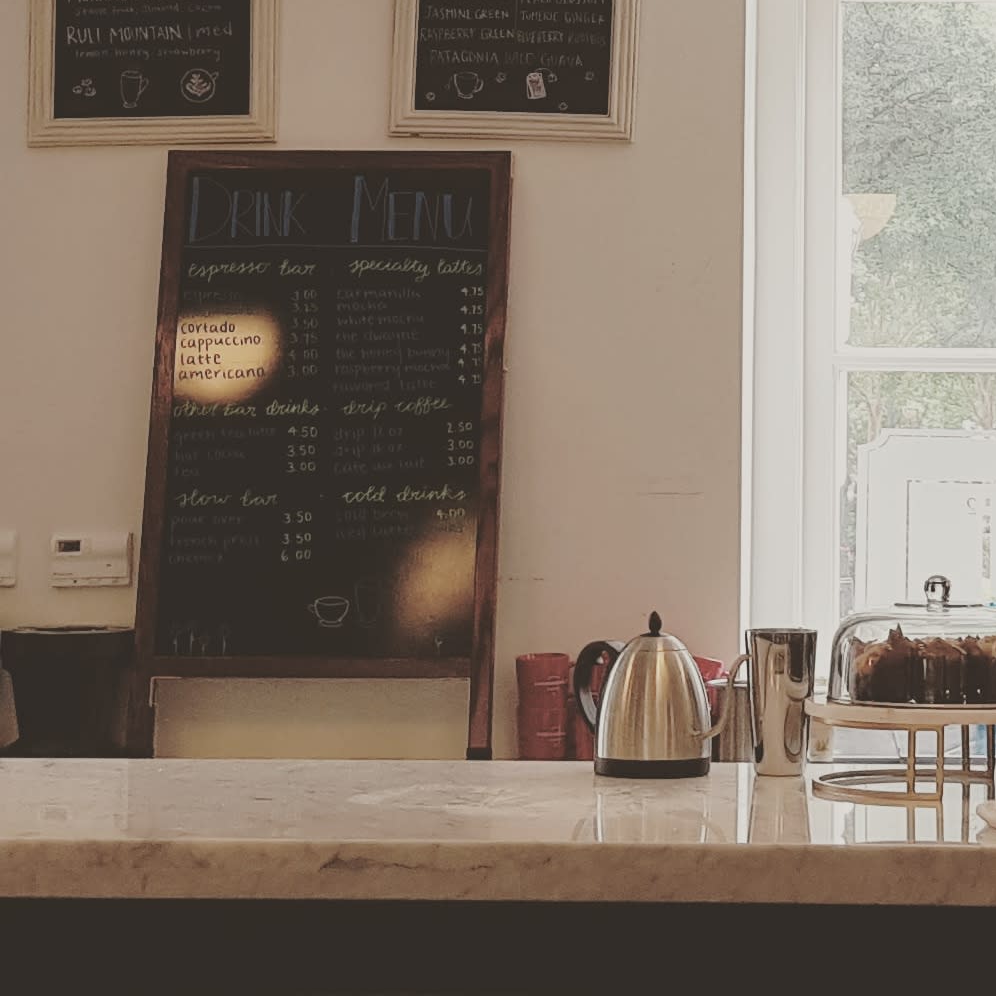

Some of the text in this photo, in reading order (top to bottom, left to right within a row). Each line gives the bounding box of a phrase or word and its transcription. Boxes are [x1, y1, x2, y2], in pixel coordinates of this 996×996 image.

[425, 5, 471, 20] JASMINE
[66, 20, 233, 45] RULI MOUNTAIN med
[431, 49, 499, 64] PATAGONIA
[189, 174, 474, 245] DRINK MENU
[188, 259, 318, 283] espresso bar
[348, 258, 484, 281] specialty lattes
[181, 320, 236, 335] cortado
[180, 335, 262, 352] cappuccino
[180, 353, 222, 365] latte
[178, 366, 265, 381] americano
[223, 404, 257, 417] bar
[265, 399, 320, 416] drinks
[342, 396, 453, 419] drip coffee
[287, 426, 318, 438] 4.50
[447, 422, 473, 434] 2.50
[287, 444, 316, 457] 3.50
[447, 440, 474, 451] 3.00
[286, 462, 316, 473] 3.00
[447, 456, 474, 467] 3.00
[174, 488, 279, 508] slow bar
[342, 484, 466, 503] cold drinks
[282, 511, 312, 524] 3.50
[282, 533, 312, 545] 3.50
[281, 550, 312, 562] 6.00
